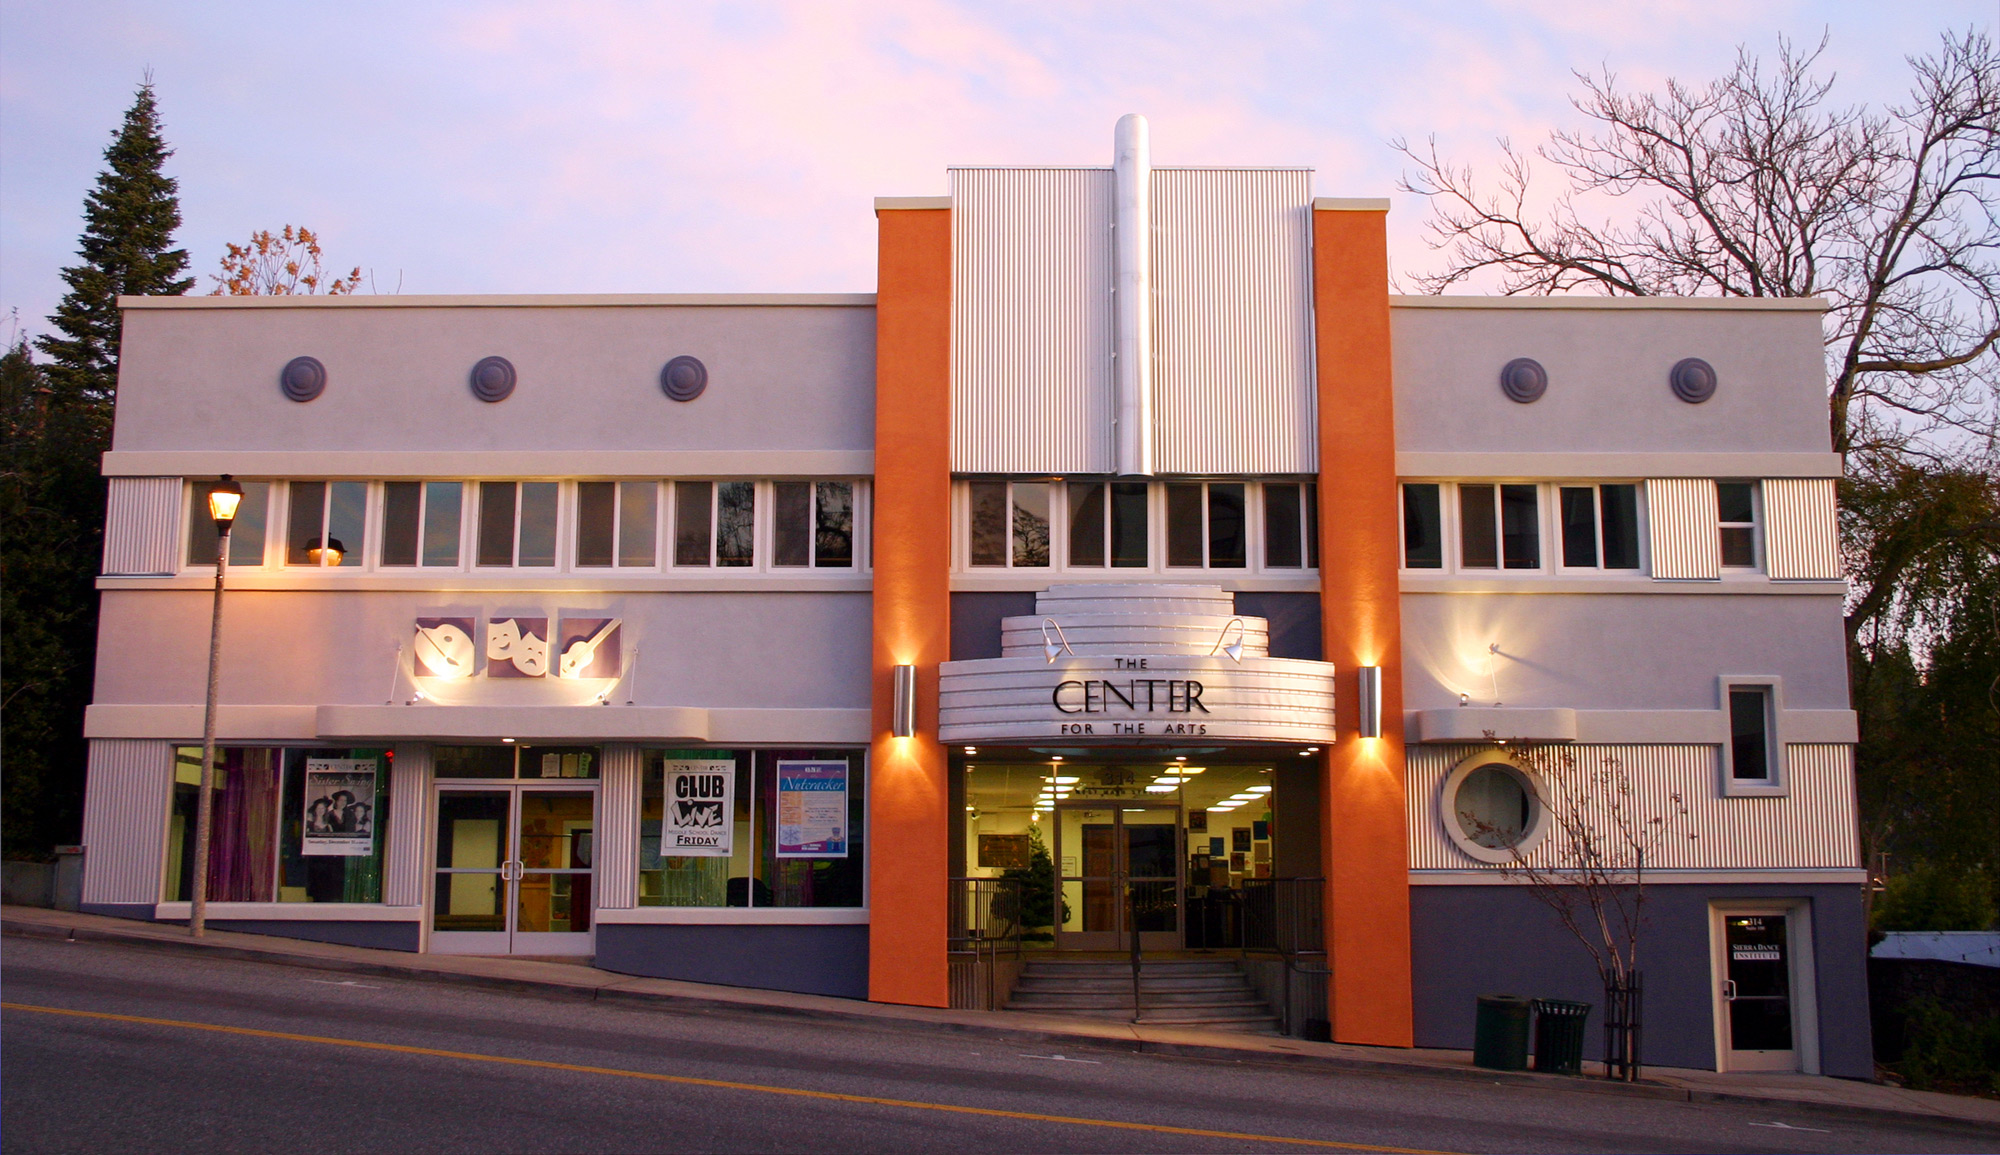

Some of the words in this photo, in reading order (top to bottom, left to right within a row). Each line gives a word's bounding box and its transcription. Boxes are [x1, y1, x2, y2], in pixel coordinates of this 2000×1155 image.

[1115, 658, 1147, 669] THE
[1052, 679, 1210, 714] CENTER
[1061, 724, 1093, 735] FOR
[1113, 723, 1145, 734] THE
[1165, 724, 1207, 735] ARTS
[783, 771, 845, 790] Nutcracker
[1104, 772, 1135, 785] 314
[676, 775, 724, 798] CLUB
[677, 835, 719, 845] FRIDAY
[1748, 918, 1762, 926] 314
